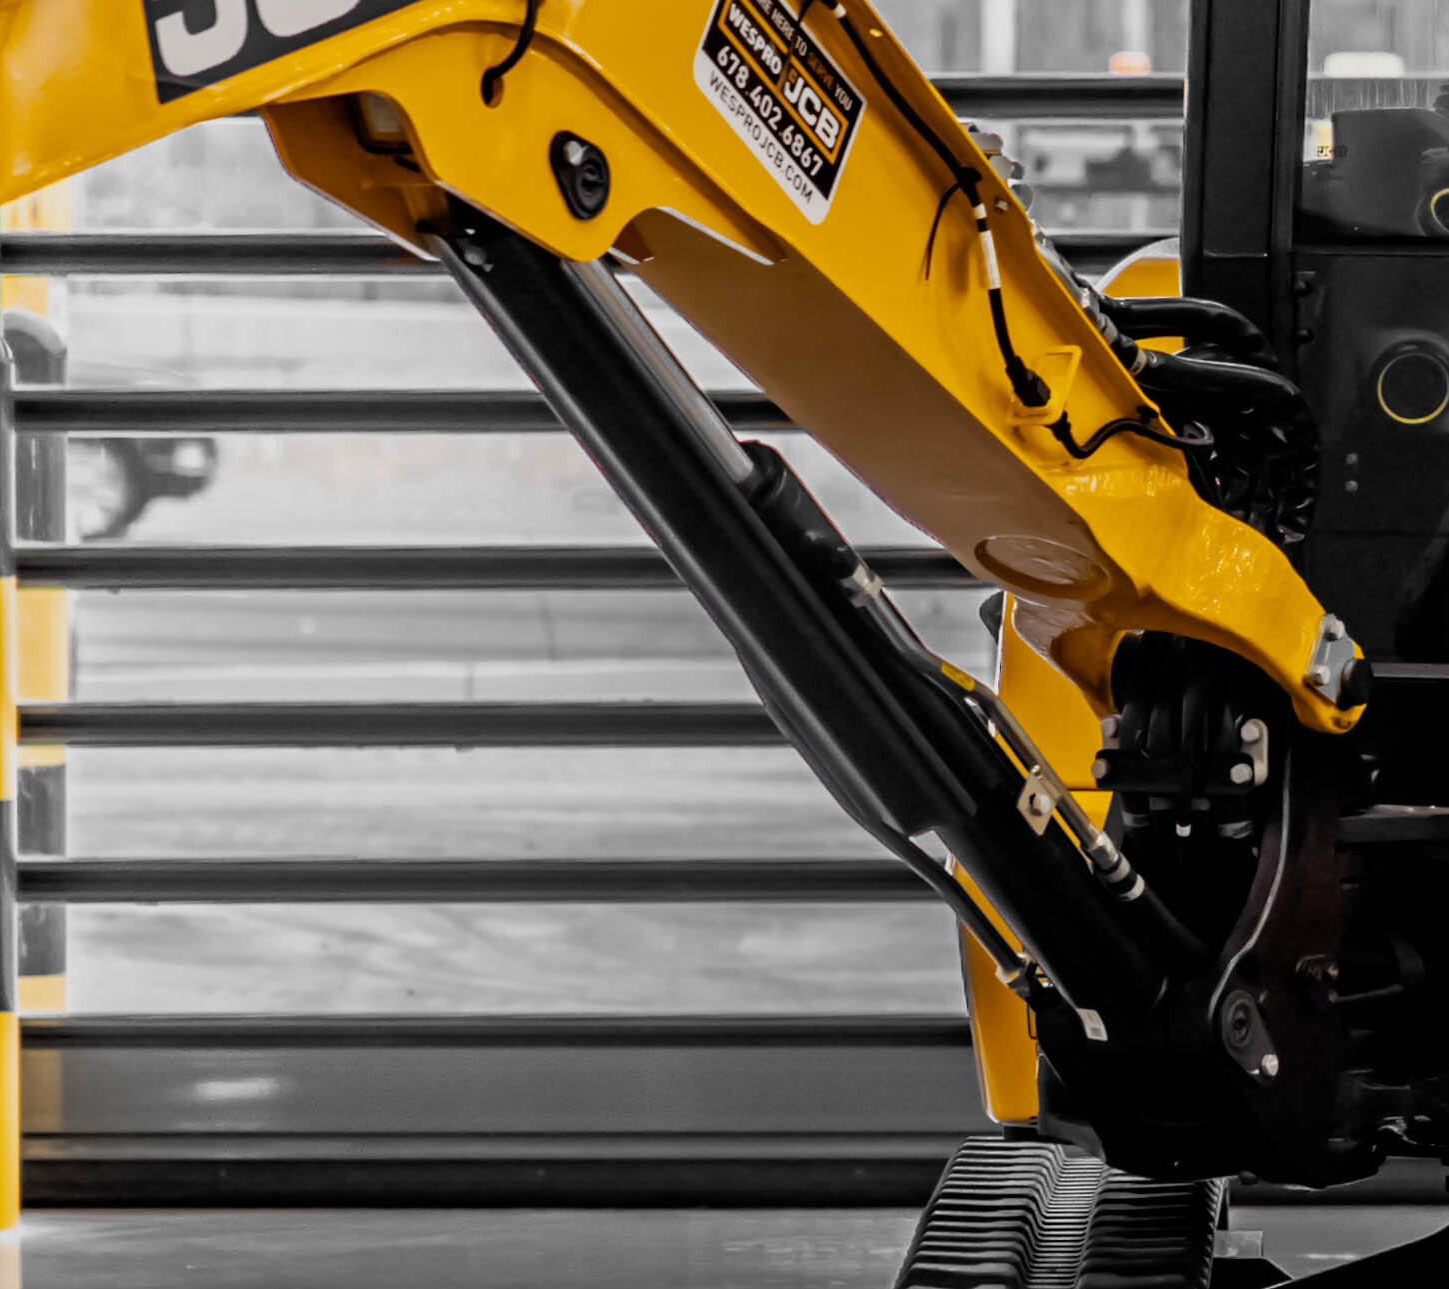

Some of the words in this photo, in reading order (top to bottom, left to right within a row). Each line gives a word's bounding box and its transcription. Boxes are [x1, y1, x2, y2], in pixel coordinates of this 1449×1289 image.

[716, 46, 824, 176] 678.402.6867
[728, 3, 783, 76] WESPRO
[783, 67, 841, 150] JCB
[770, 7, 795, 43] HERE
[794, 35, 809, 57] TO
[833, 83, 854, 112] YOU
[709, 70, 814, 203] WESPROJCB.COM
